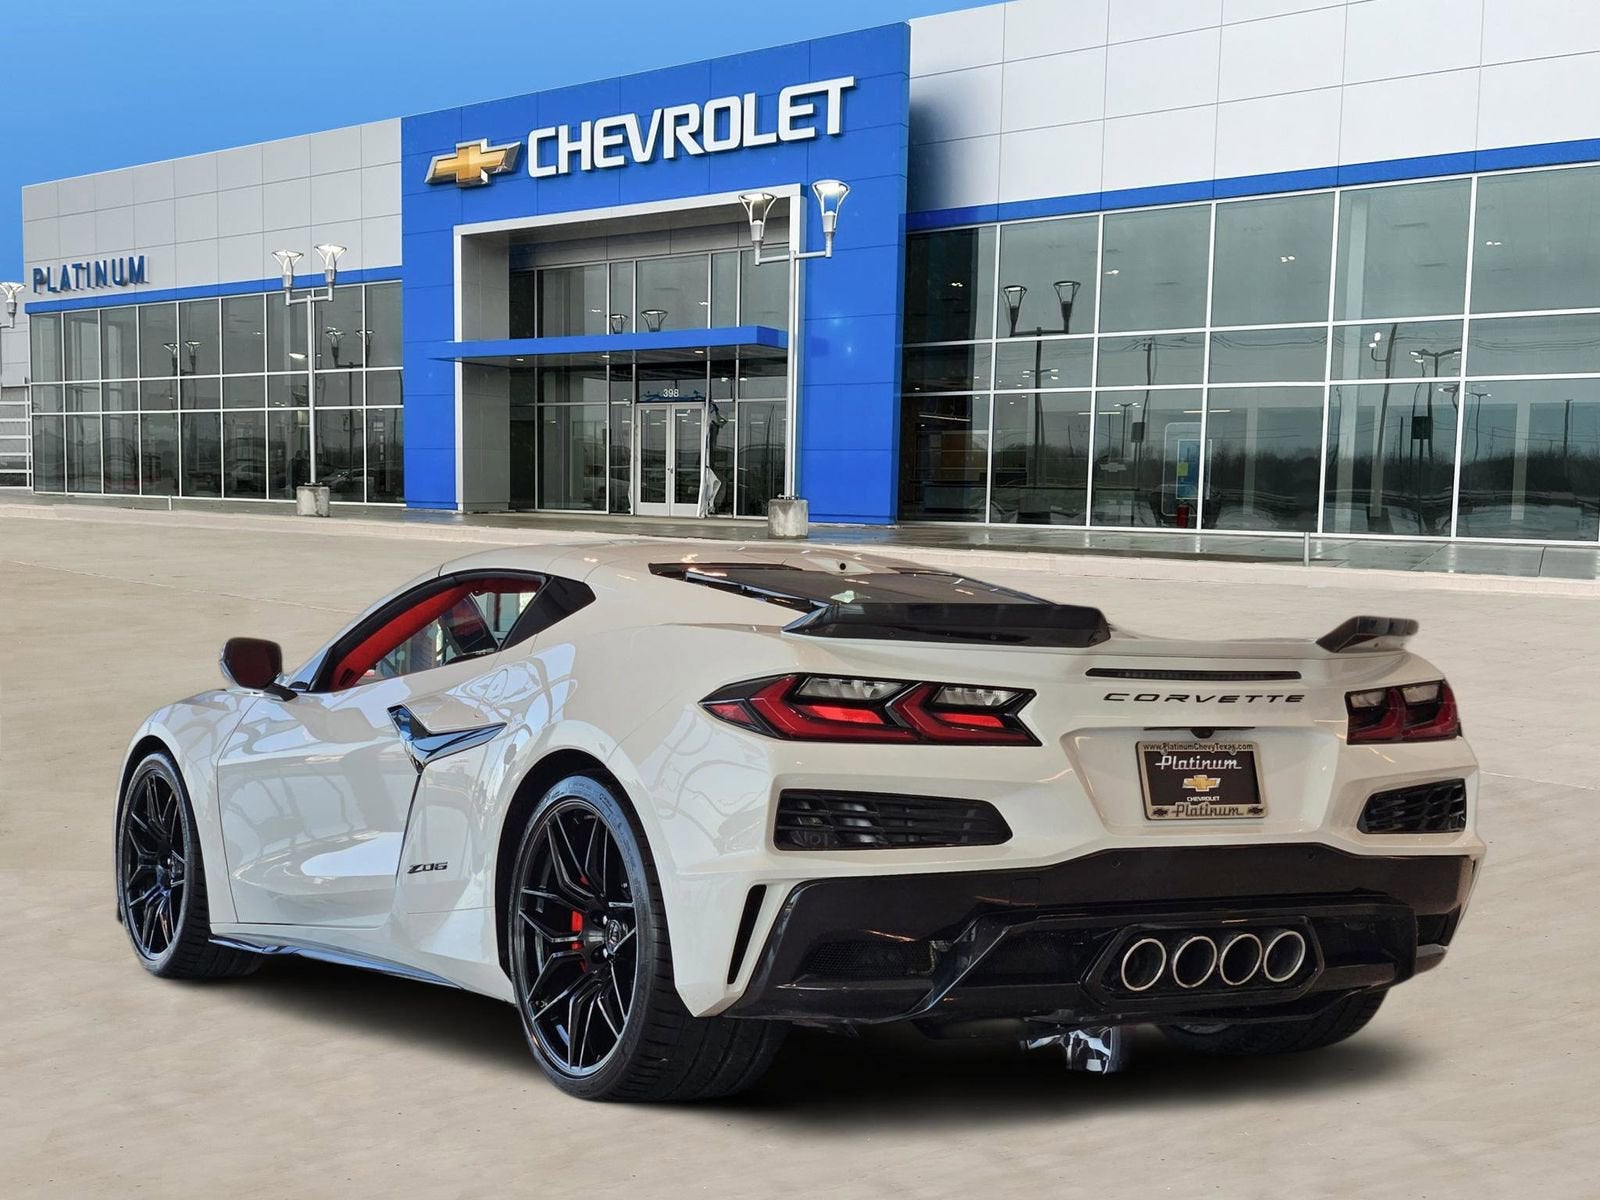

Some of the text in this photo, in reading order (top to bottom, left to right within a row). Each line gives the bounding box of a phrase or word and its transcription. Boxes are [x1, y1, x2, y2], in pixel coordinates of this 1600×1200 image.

[527, 75, 856, 178] CHEVROLET
[33, 255, 147, 294] PLATINUM
[663, 388, 679, 398] 398
[1103, 692, 1305, 703] CORVETTE
[1155, 755, 1242, 770] Platinum
[1172, 803, 1243, 817] Platinum
[407, 861, 448, 874] Z06
